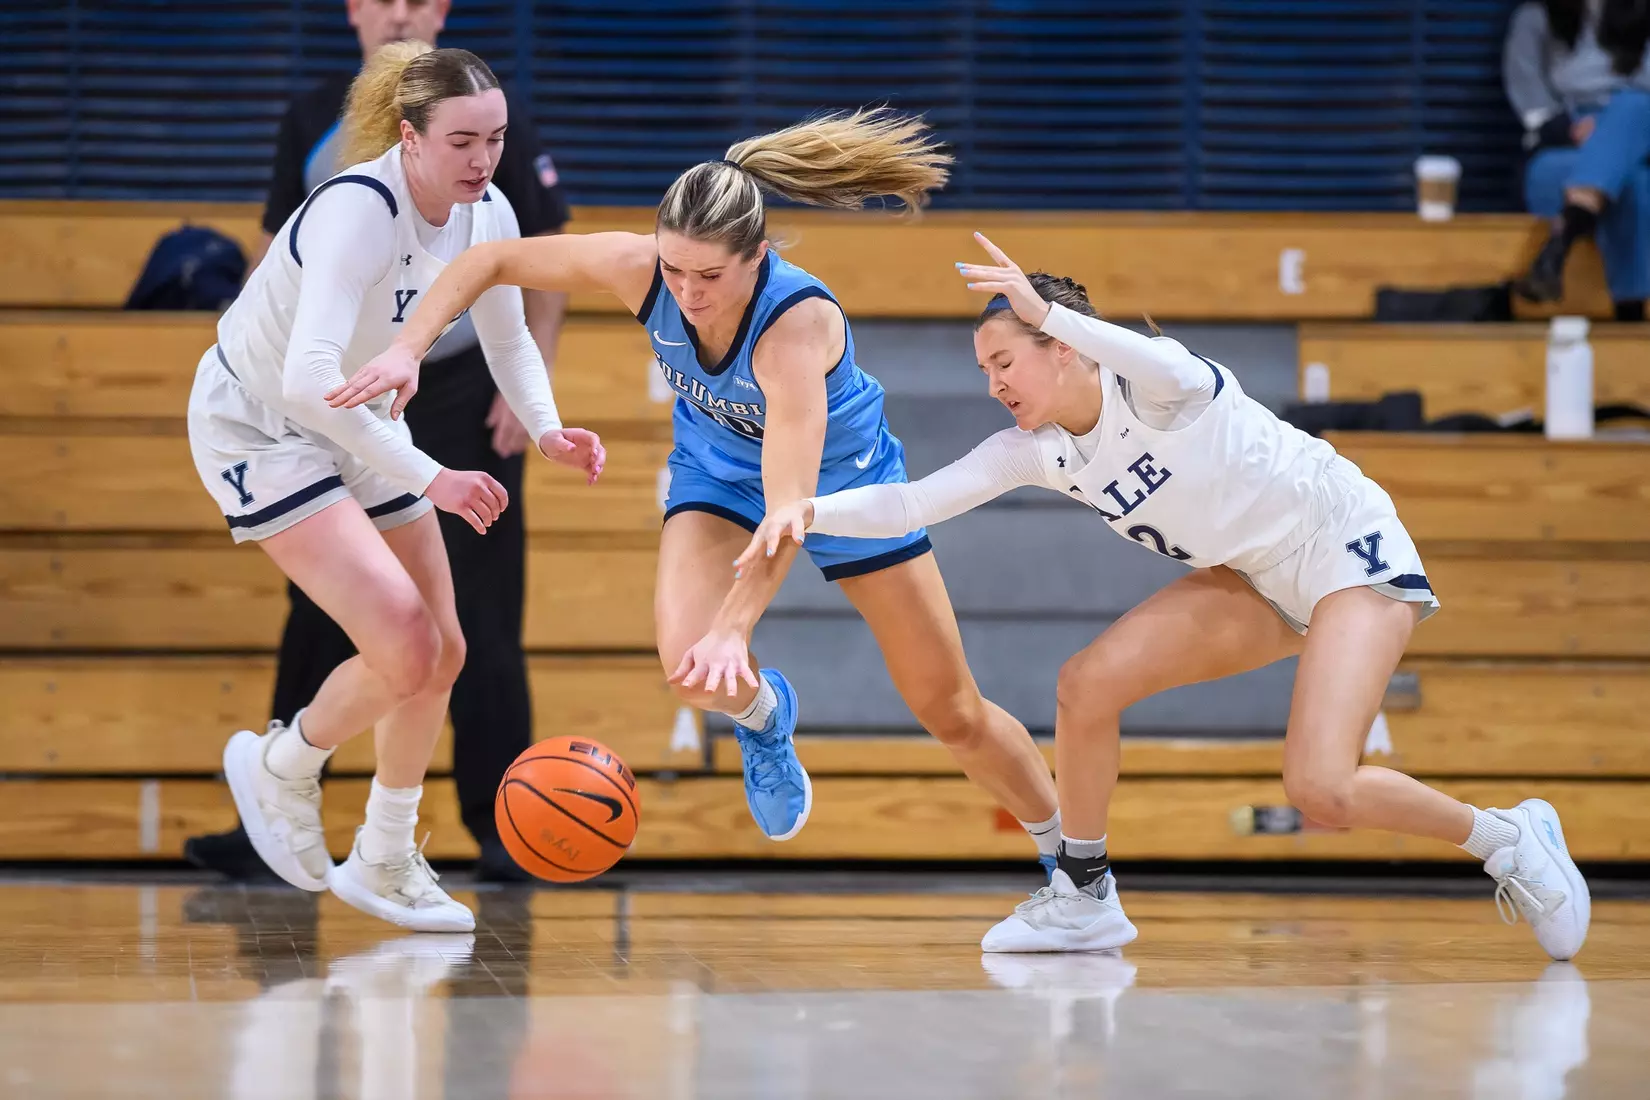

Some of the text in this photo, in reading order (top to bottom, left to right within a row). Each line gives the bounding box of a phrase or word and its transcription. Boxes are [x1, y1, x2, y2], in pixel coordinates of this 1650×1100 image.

[1279, 248, 1306, 294] E
[220, 460, 256, 508] Y
[1345, 530, 1391, 578] Y
[670, 706, 701, 752] A
